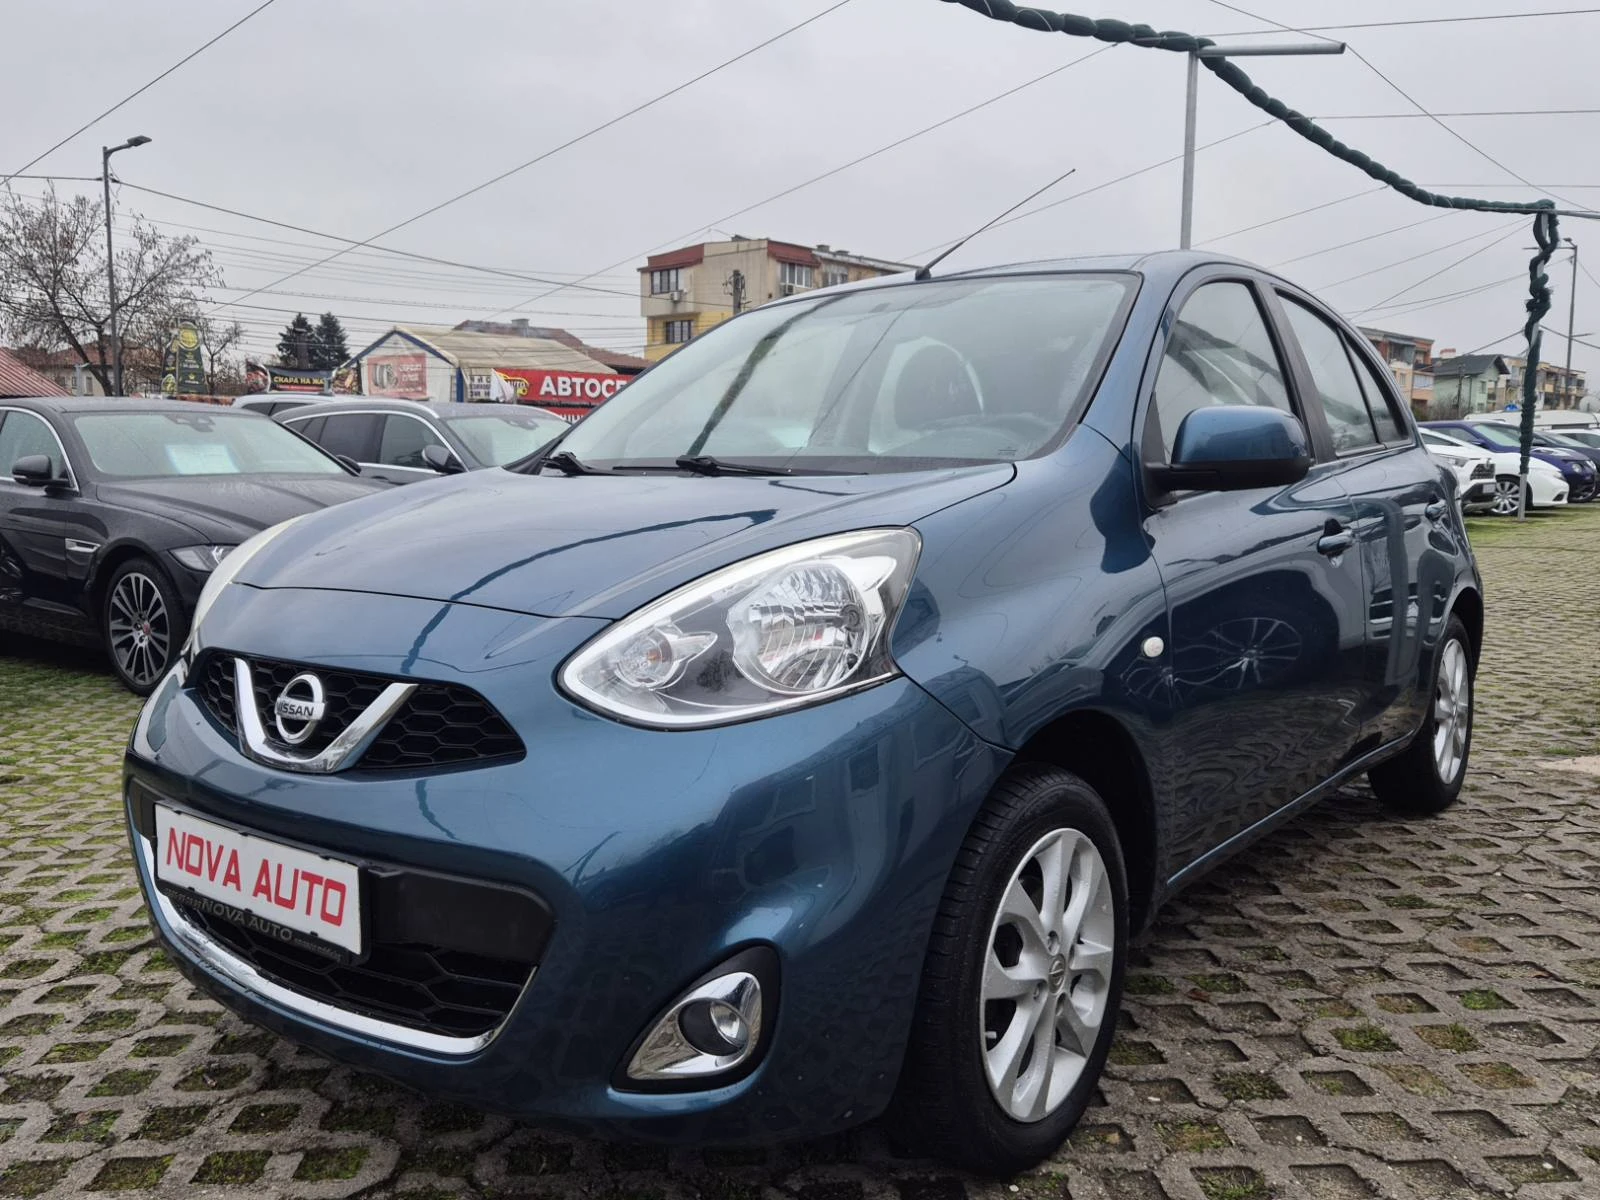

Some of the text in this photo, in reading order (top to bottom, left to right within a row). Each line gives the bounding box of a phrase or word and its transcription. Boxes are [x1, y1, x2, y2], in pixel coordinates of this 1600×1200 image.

[273, 376, 299, 385] СКАРА
[300, 376, 311, 385] НА
[166, 827, 347, 927] NOVA AUTO
[201, 900, 293, 942] NOVA AUTO
